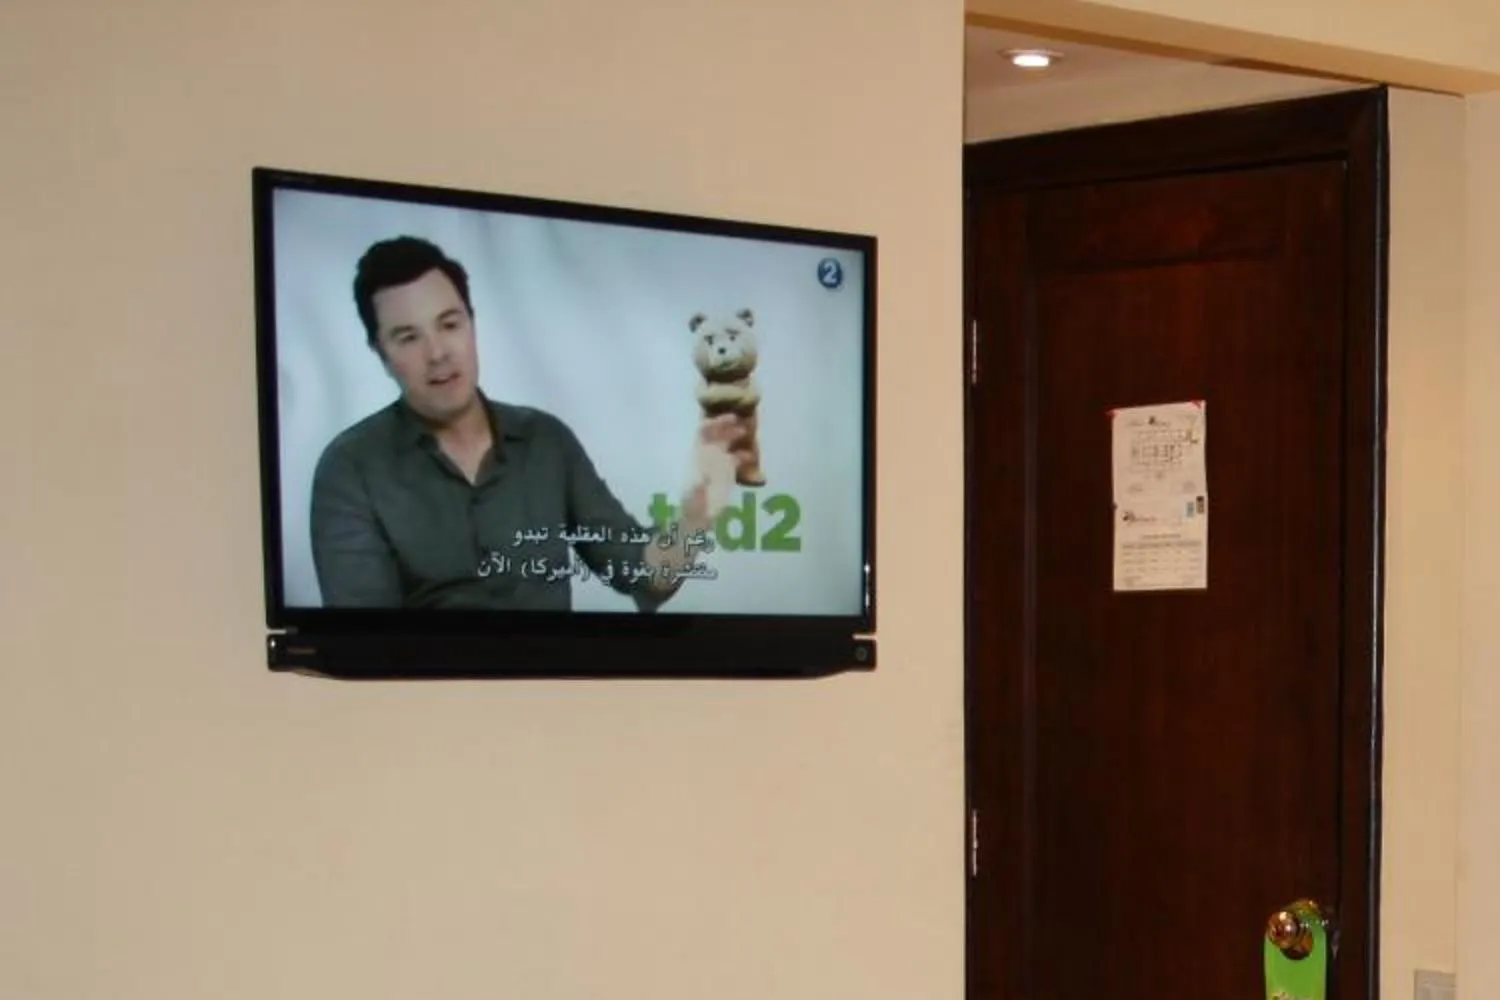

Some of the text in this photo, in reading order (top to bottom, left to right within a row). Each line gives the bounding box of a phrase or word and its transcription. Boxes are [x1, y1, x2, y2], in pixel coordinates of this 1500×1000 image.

[823, 262, 837, 284] 2
[648, 490, 802, 551] td2
[511, 527, 549, 548] تبدو
[558, 523, 613, 545] العقلية
[621, 527, 652, 543] هذه
[600, 558, 615, 586] في
